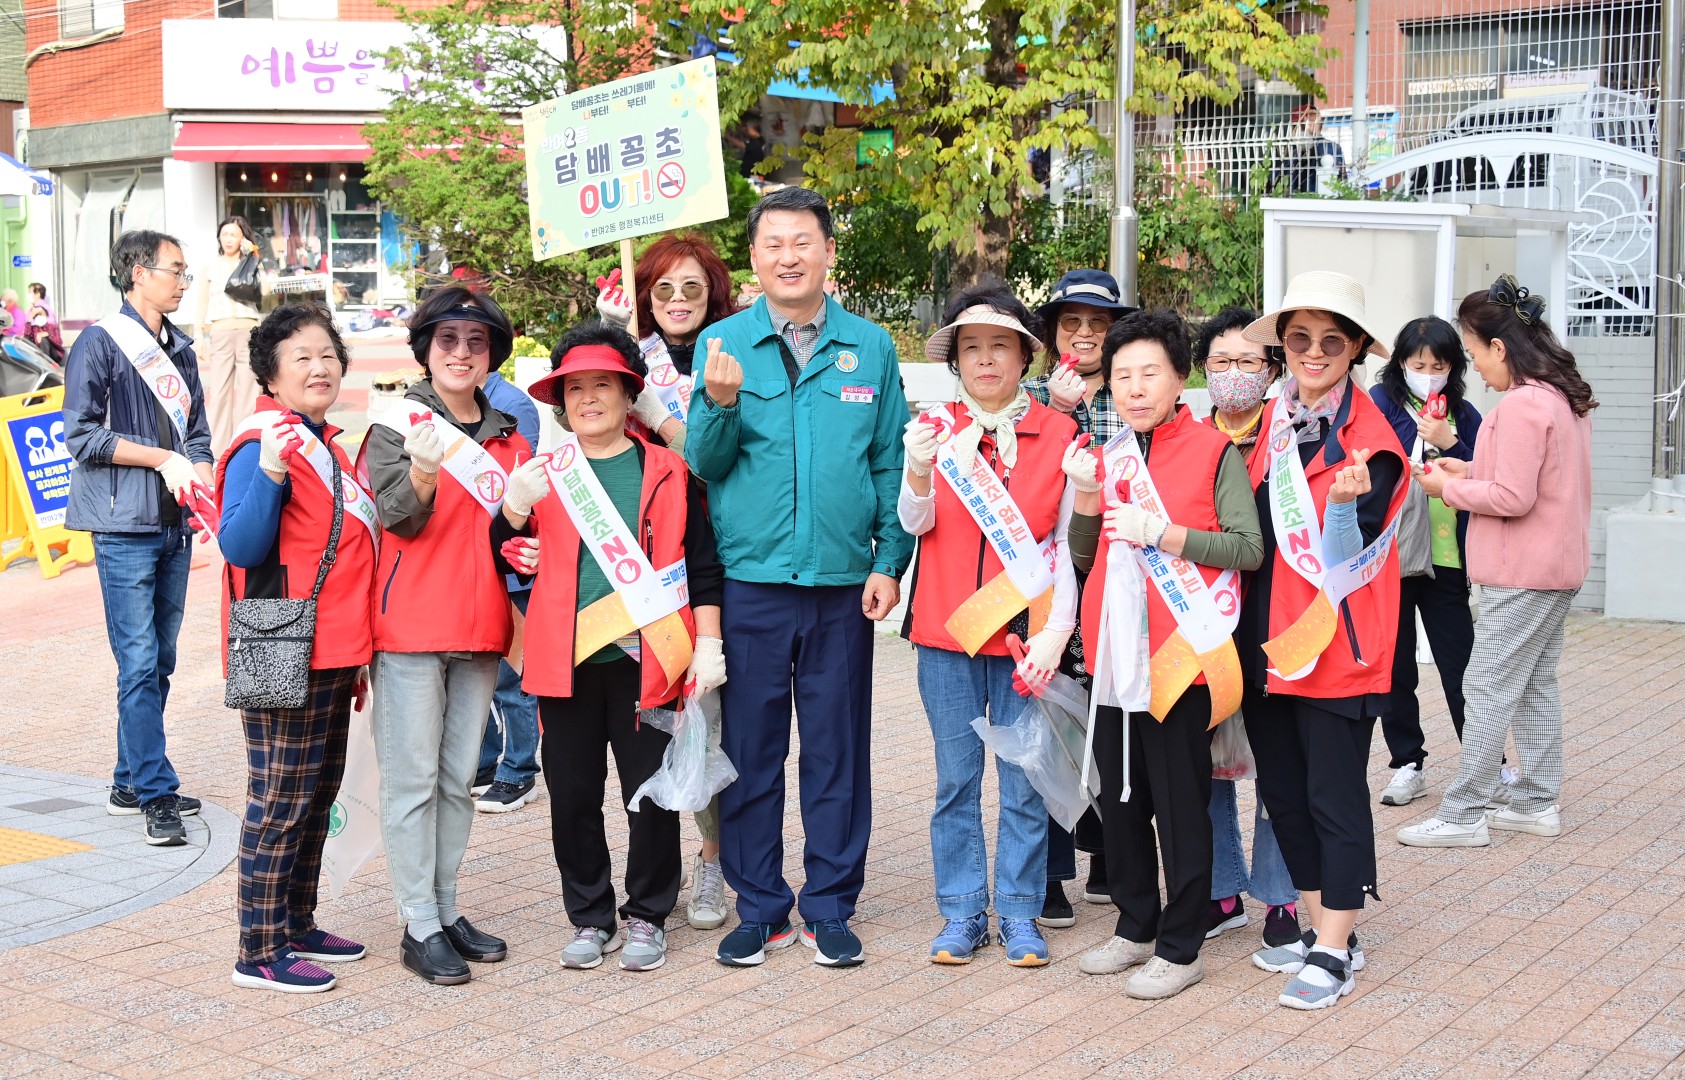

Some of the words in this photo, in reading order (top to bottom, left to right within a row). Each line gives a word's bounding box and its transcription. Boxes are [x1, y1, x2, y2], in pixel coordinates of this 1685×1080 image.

[241, 38, 376, 94] 예쁨을
[571, 92, 610, 111] 담배꽁초는
[611, 79, 656, 100] 쓰레기통에!
[582, 104, 609, 121] 나부터!
[579, 168, 653, 217] OUT!
[590, 222, 617, 238] 반여2동
[618, 212, 664, 232] 행정복지센터
[562, 468, 614, 541] 담배꽁초
[1276, 451, 1306, 528] 담배꽁초
[968, 494, 998, 528] 해운대
[991, 528, 1018, 561] 만들기
[998, 505, 1028, 543] 없는
[1161, 579, 1190, 613] 만들기
